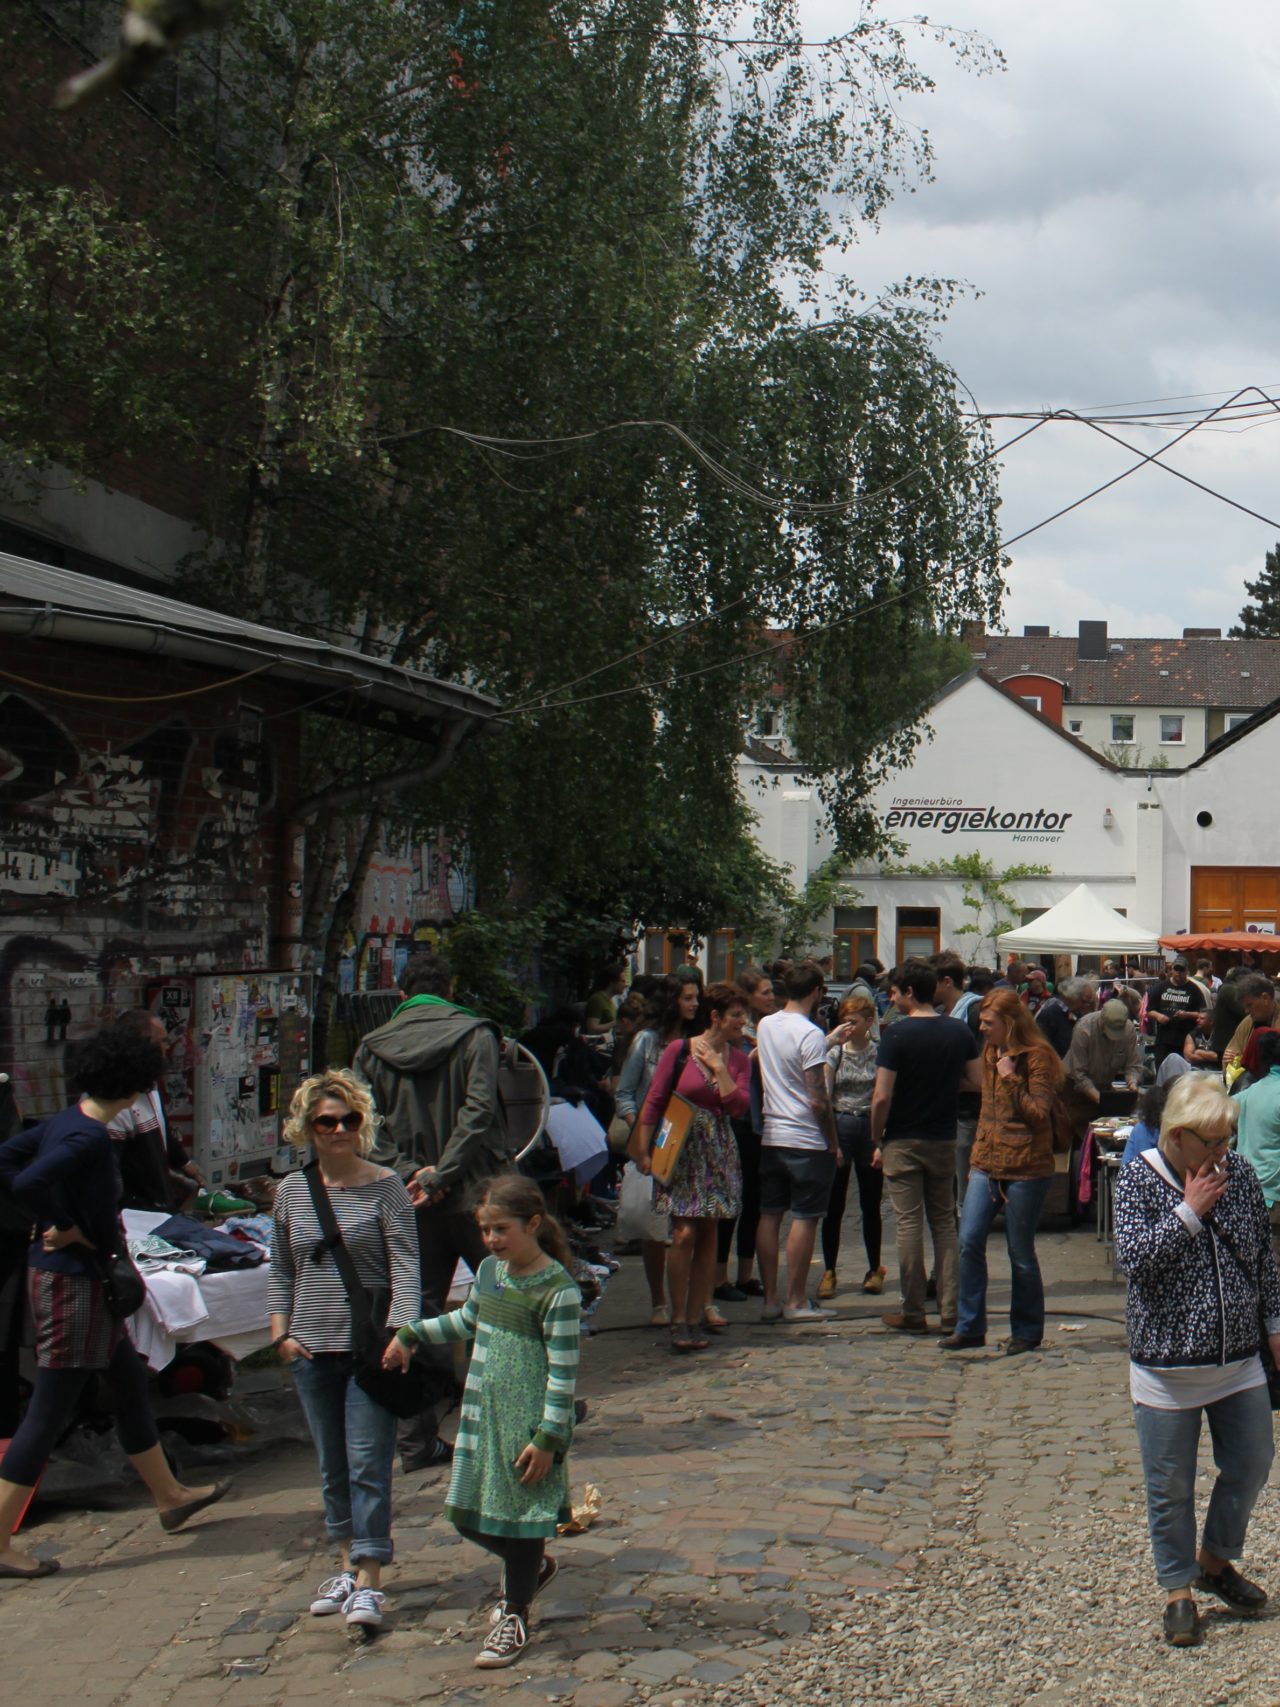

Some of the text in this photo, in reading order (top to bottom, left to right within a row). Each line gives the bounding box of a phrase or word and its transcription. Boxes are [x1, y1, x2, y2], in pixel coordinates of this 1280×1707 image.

[892, 796, 963, 806] Ingenieurbüro
[885, 806, 1072, 834] energiekontor
[1012, 834, 1062, 843] Hannover
